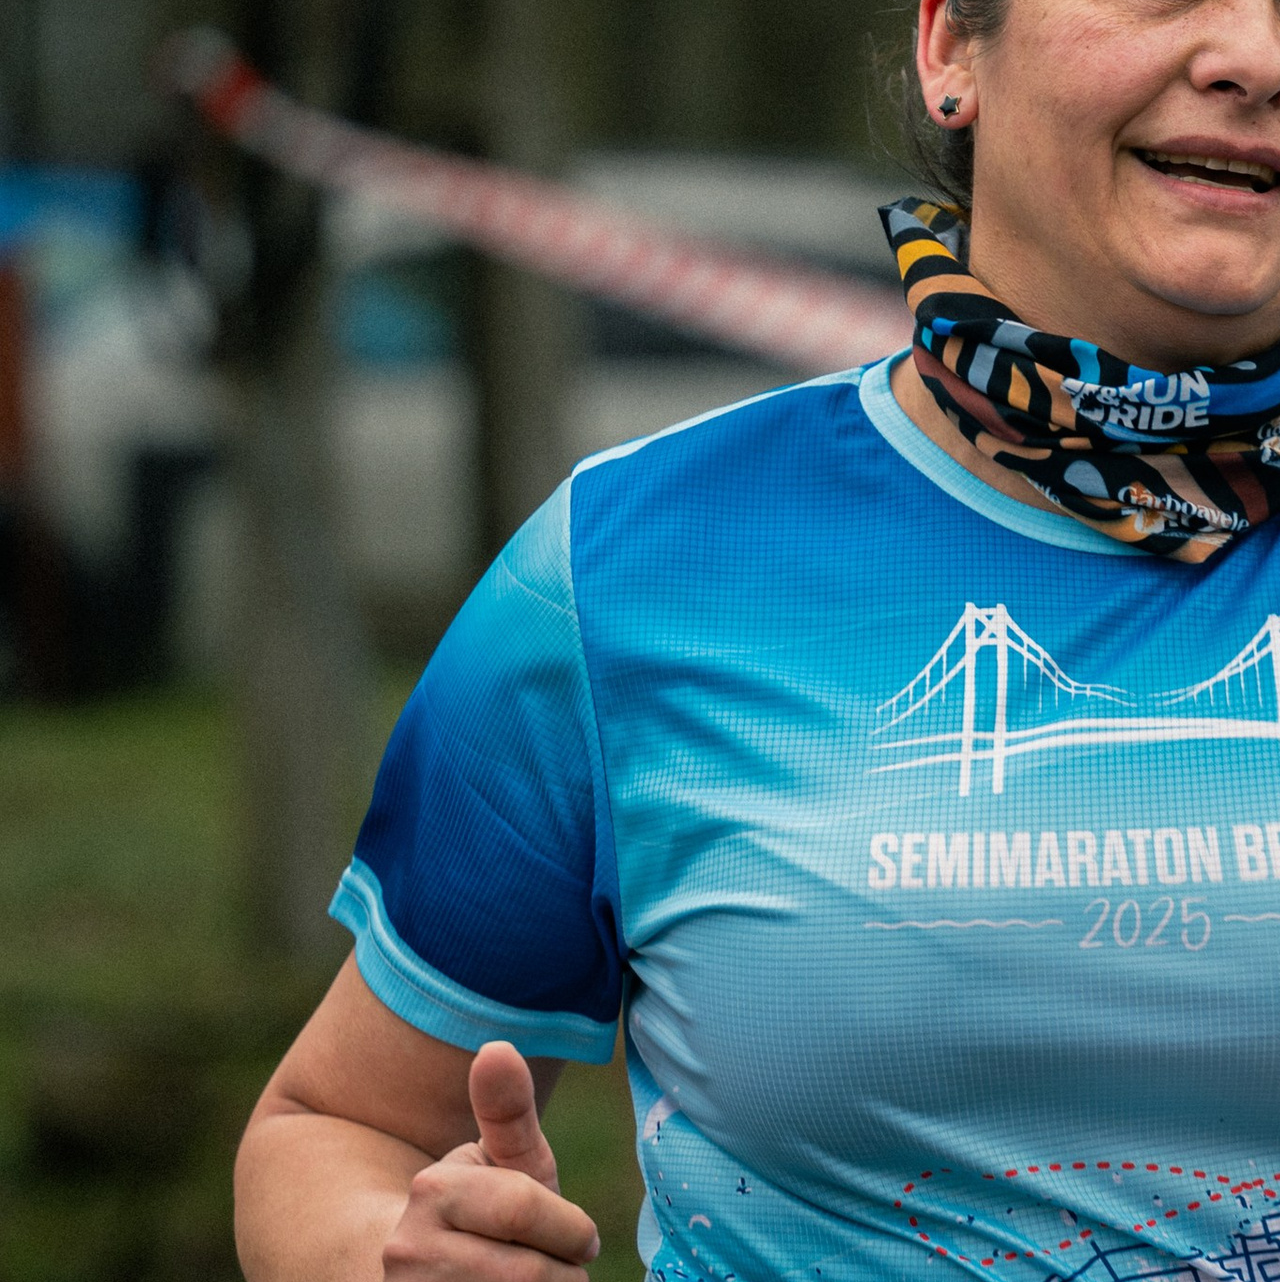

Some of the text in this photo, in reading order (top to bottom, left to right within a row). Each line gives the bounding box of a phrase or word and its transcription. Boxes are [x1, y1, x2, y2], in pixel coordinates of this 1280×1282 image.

[1109, 399, 1210, 430] RIDE
[868, 826, 1224, 890] SEMIMARATON
[1079, 896, 1212, 951] 2025
